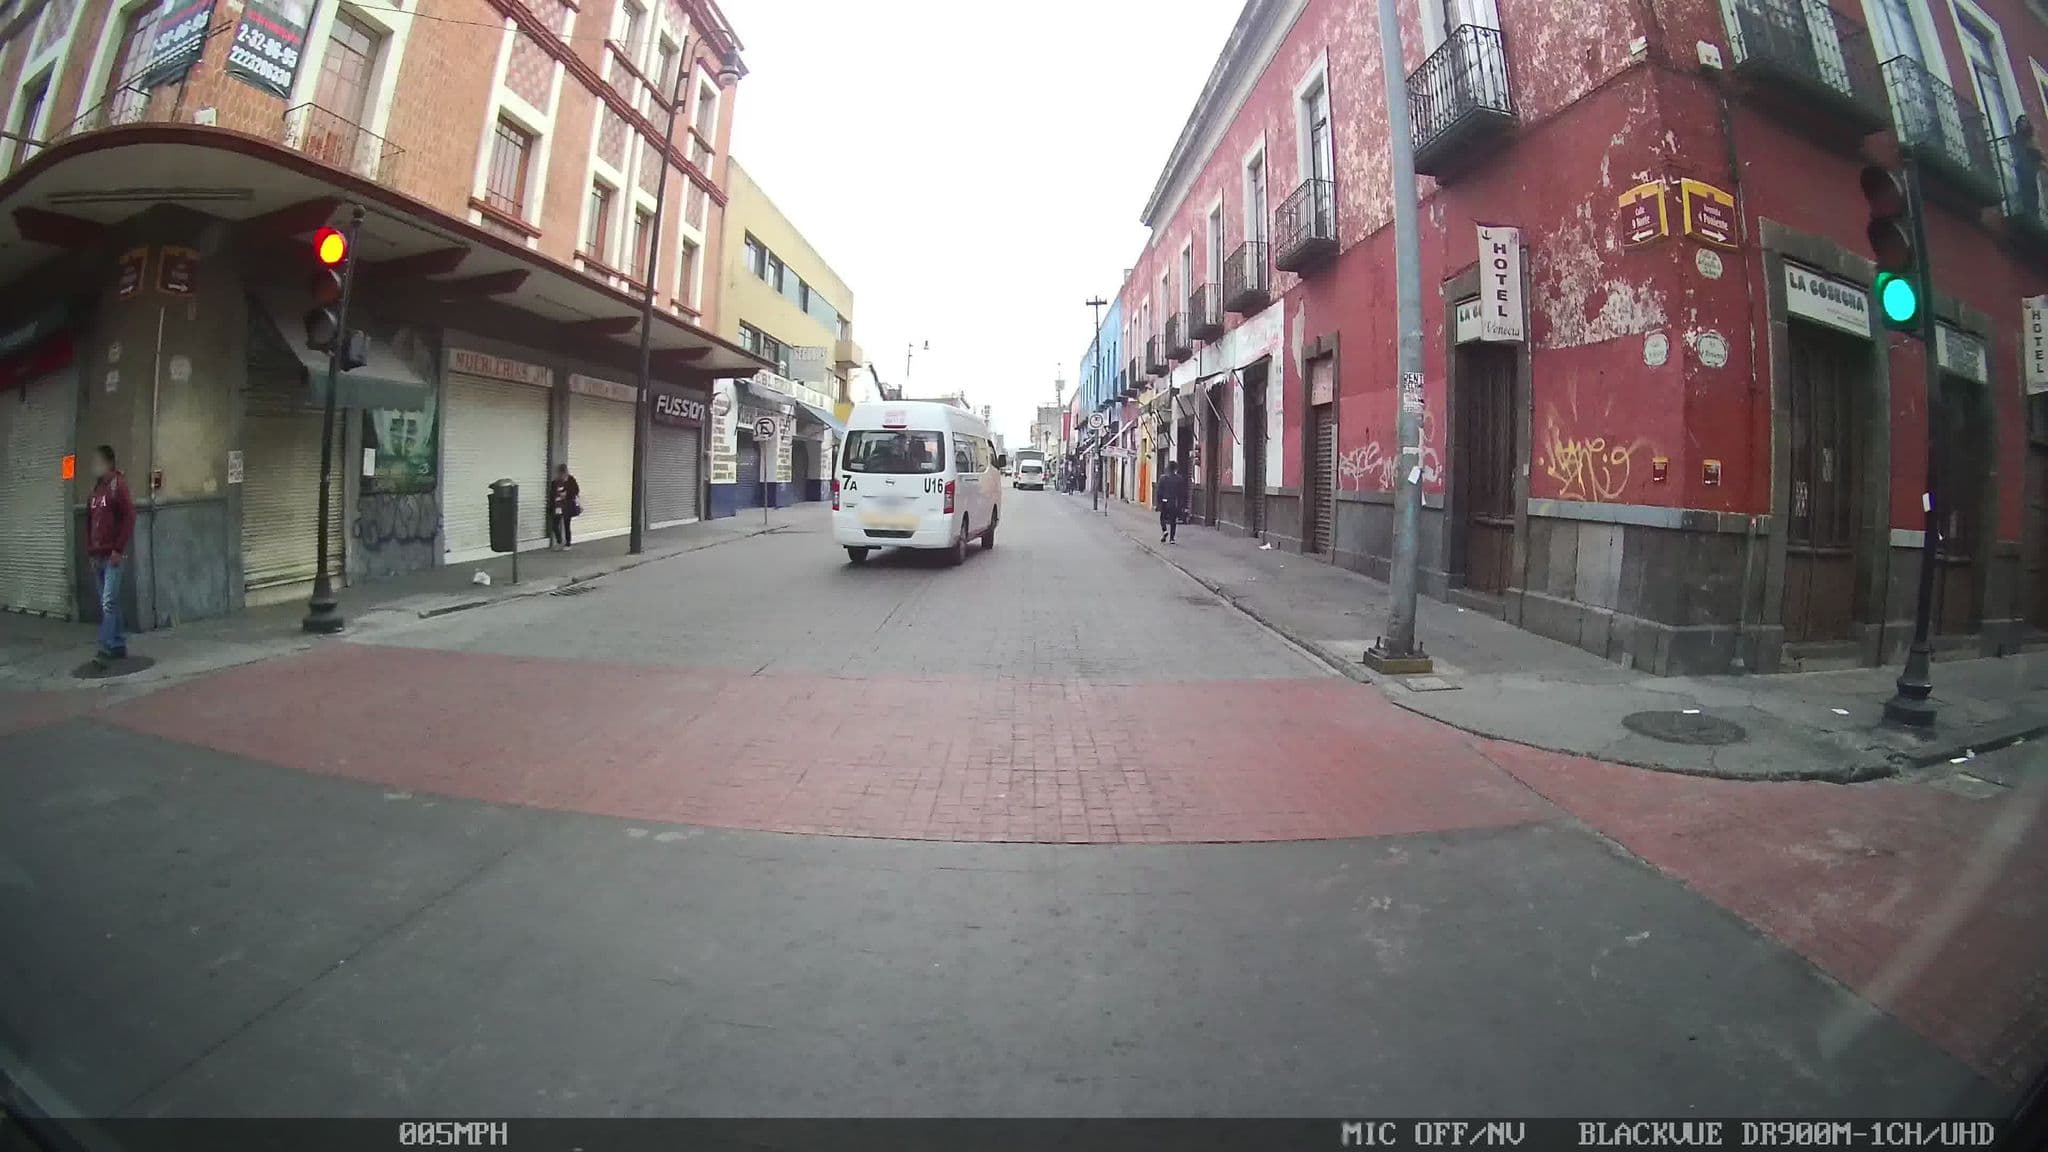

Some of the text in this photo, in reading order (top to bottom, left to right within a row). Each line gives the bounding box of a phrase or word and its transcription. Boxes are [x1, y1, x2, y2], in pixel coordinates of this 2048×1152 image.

[1493, 243, 1508, 318] HOTEL
[1790, 272, 1806, 292] LA
[2032, 310, 2044, 373] HOTEL
[924, 478, 944, 493] U16
